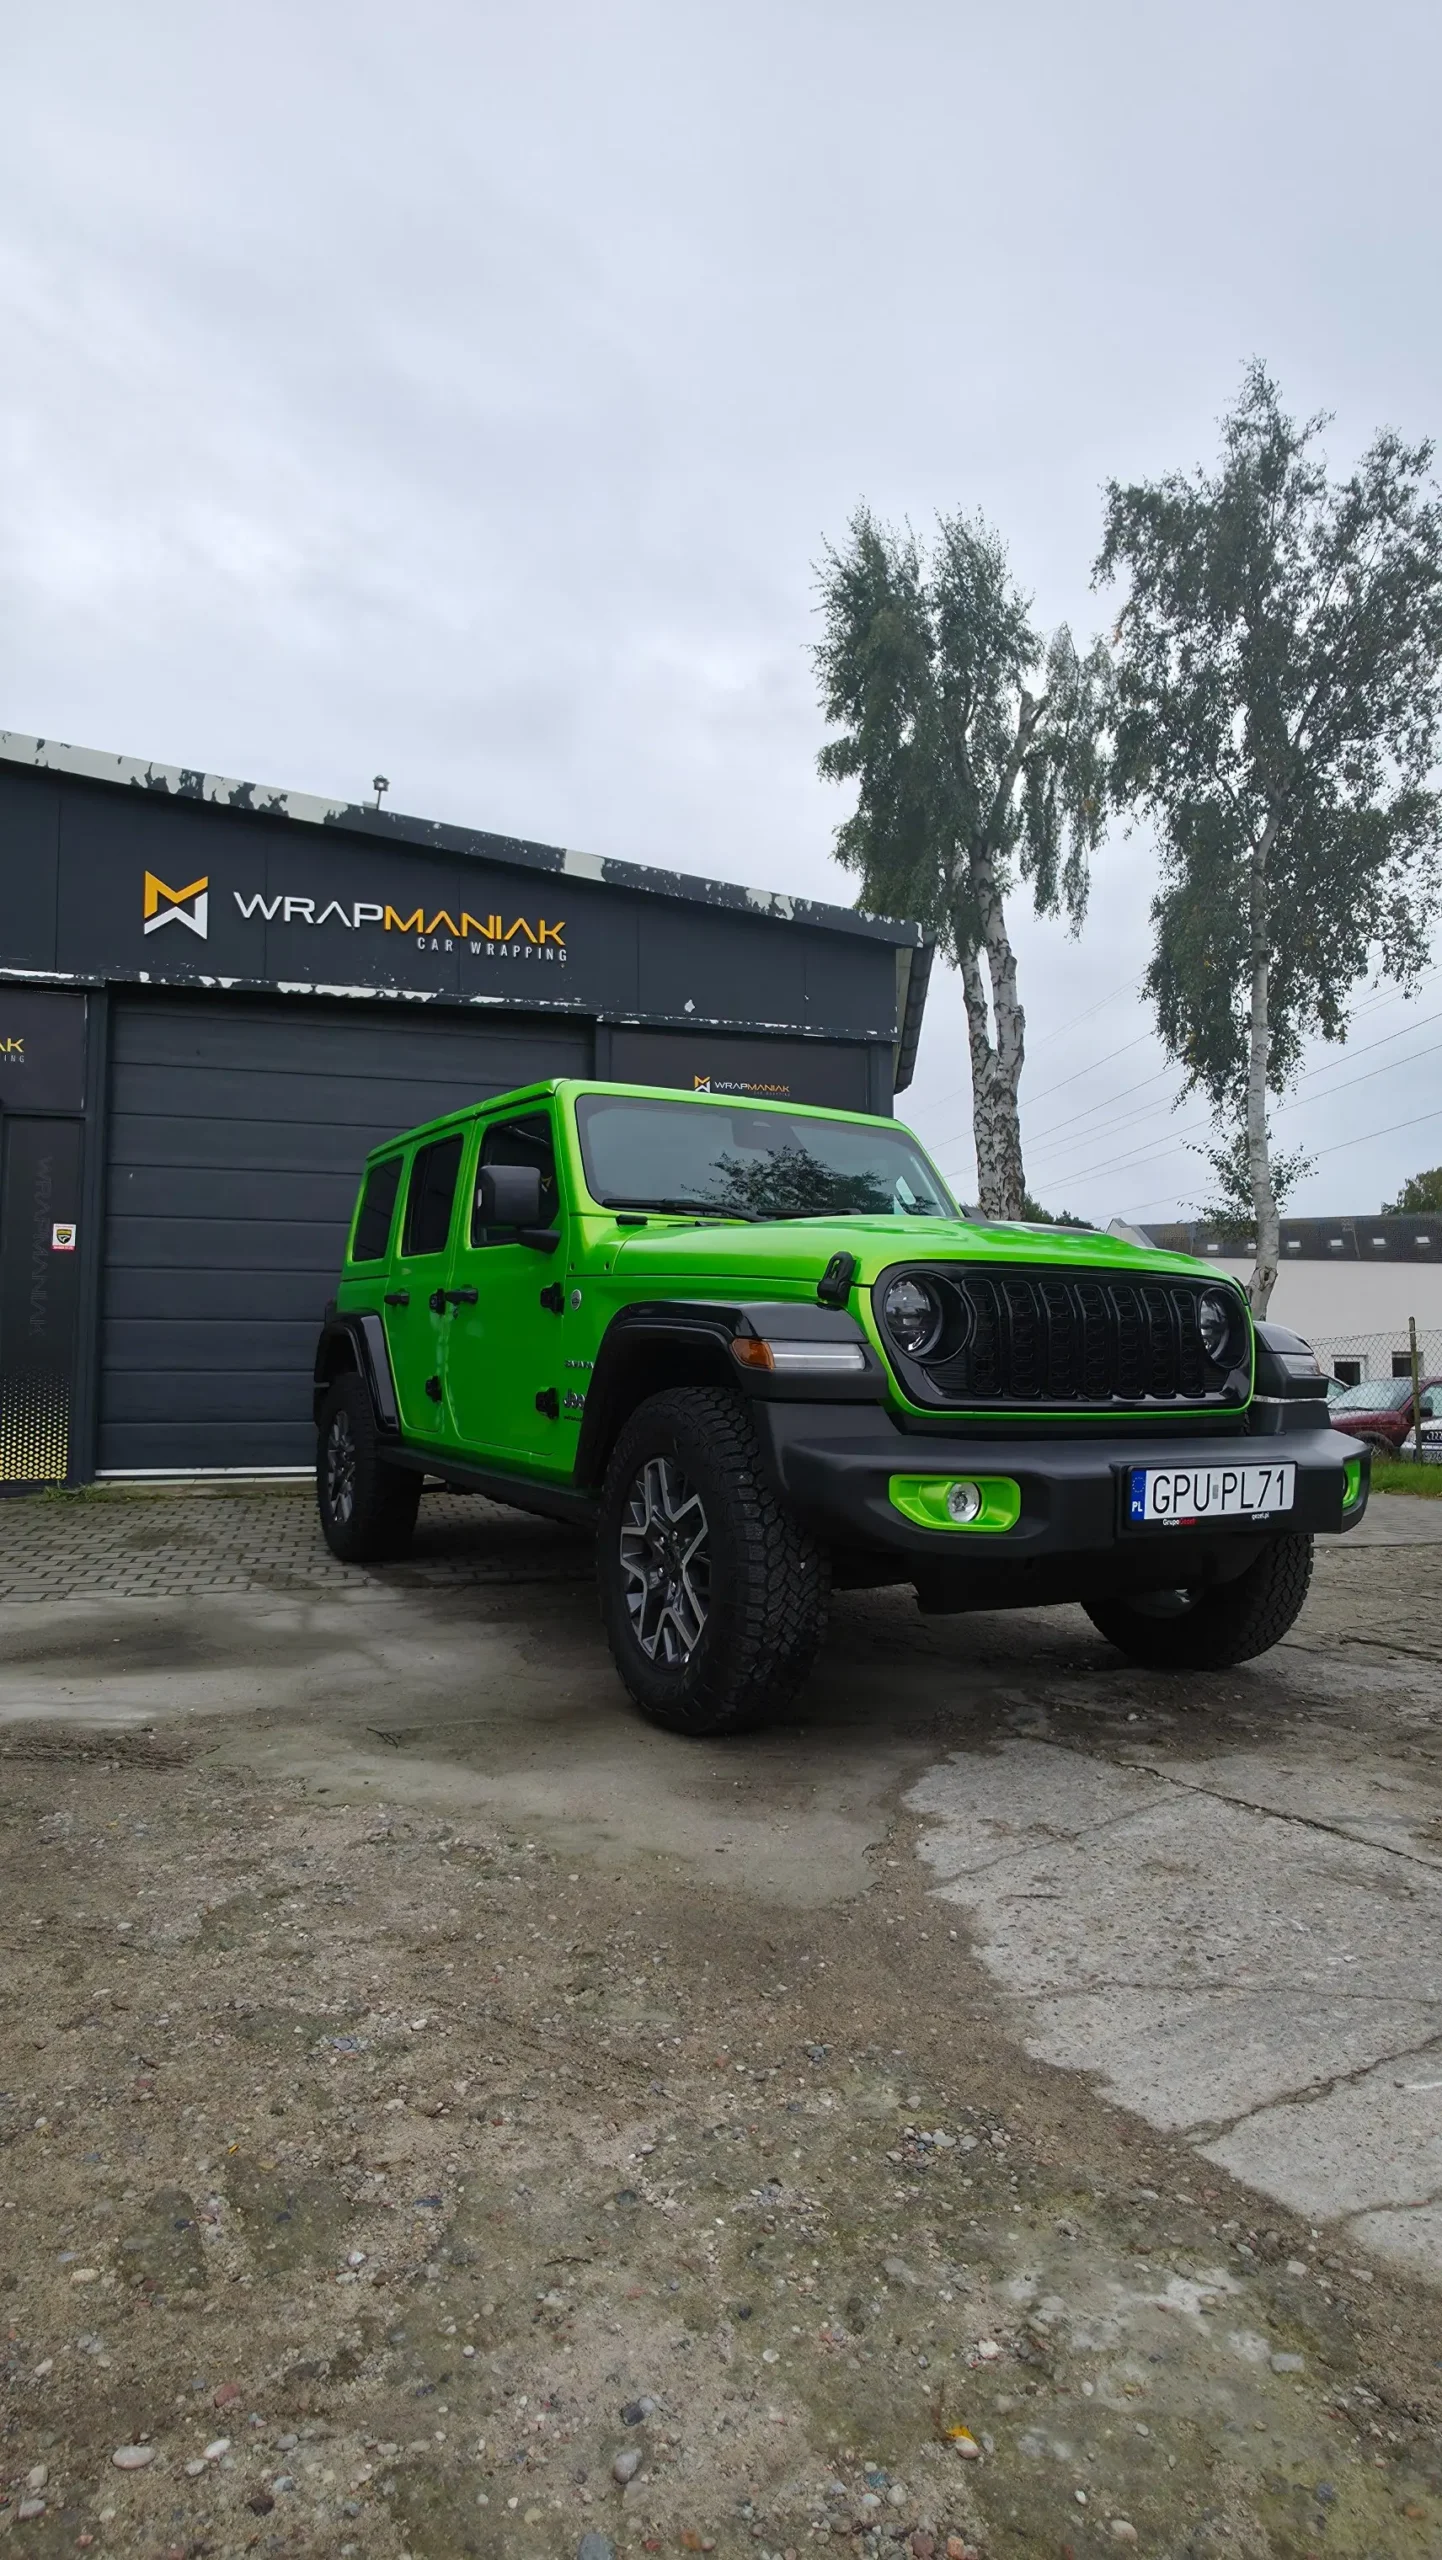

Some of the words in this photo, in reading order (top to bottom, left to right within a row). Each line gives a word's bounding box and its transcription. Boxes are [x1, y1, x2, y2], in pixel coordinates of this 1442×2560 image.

[233, 891, 566, 946] WRAPMANIAK
[417, 937, 453, 952] CAR
[470, 941, 567, 962] WRAPPING
[714, 1081, 790, 1093] WRAPMANIAK
[1153, 1473, 1211, 1514] GPU
[1221, 1469, 1285, 1511] PL71
[1131, 1501, 1143, 1512] PL
